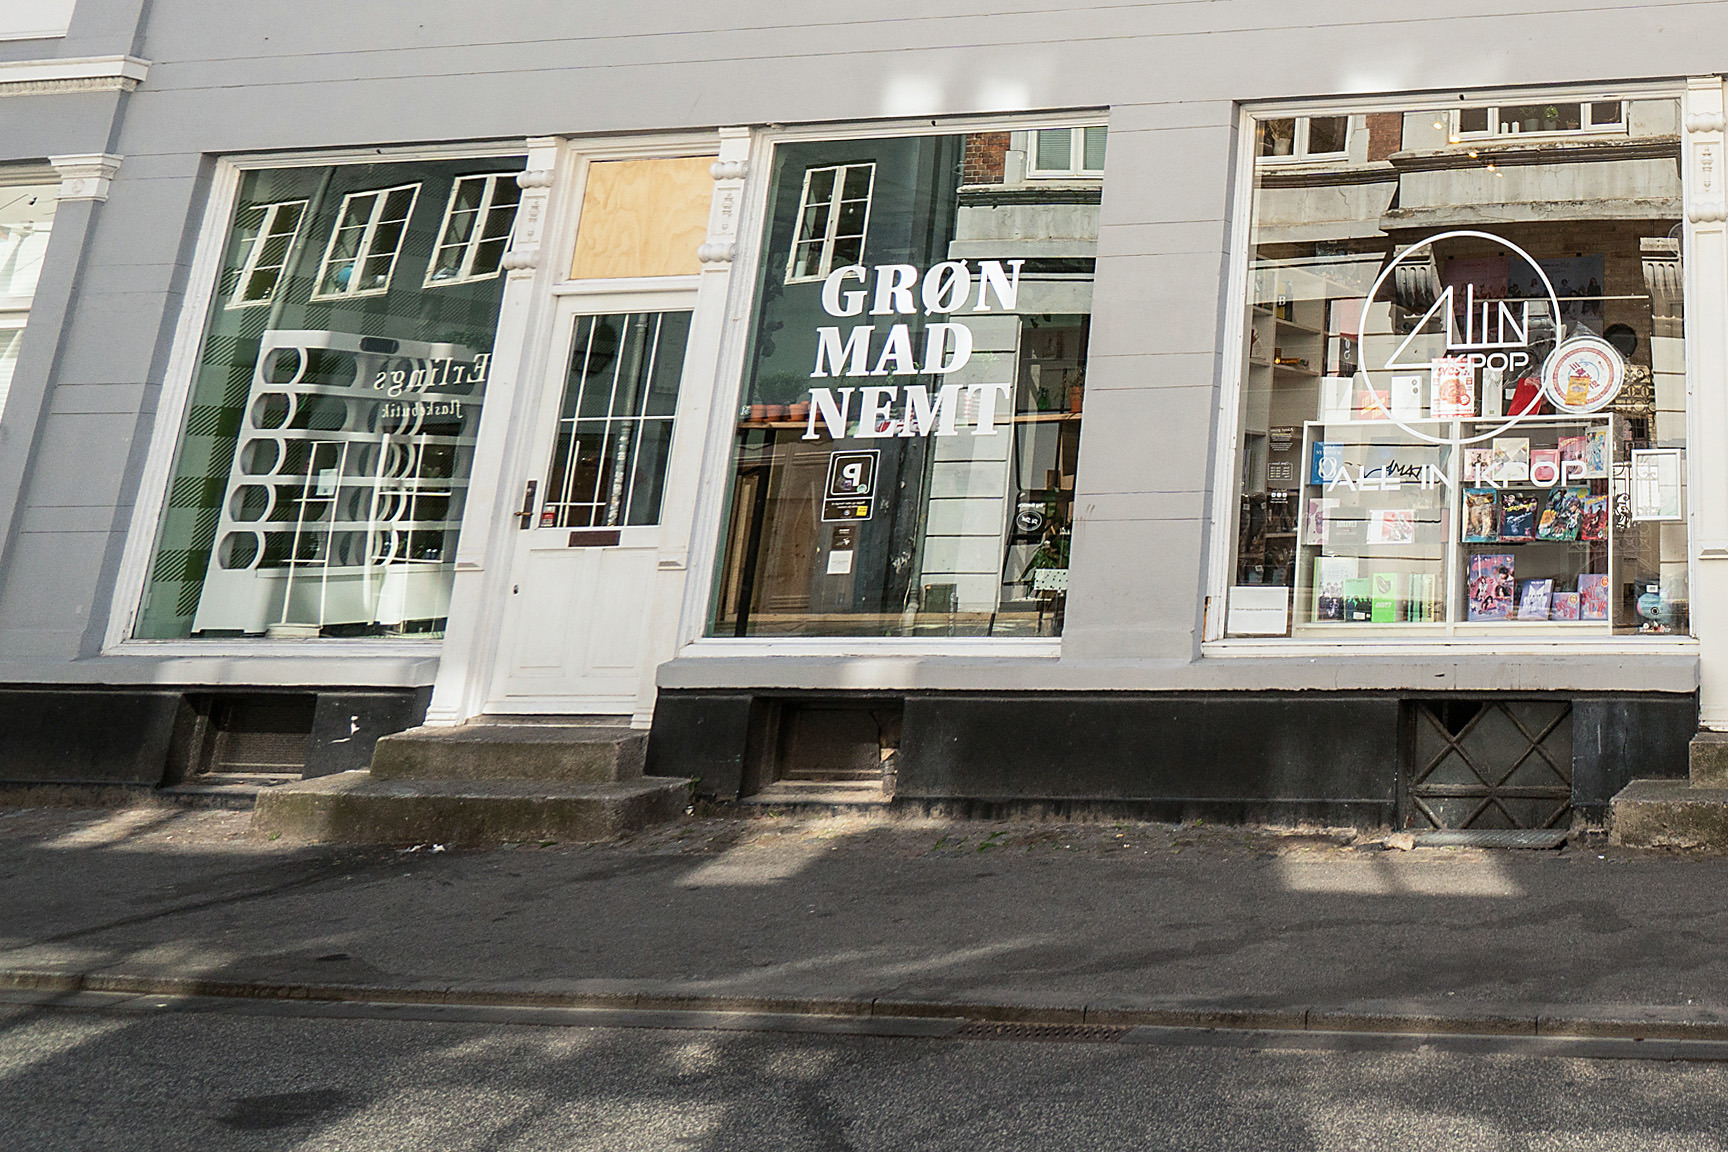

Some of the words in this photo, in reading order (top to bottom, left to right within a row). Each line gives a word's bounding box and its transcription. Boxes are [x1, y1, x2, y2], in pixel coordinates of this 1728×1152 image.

[821, 259, 1025, 317] GRØN
[810, 323, 973, 378] MAD
[1447, 352, 1529, 372] KPOP
[801, 382, 1011, 440] NEMT
[1327, 465, 1401, 492] ALL
[1421, 463, 1453, 491] IN
[1475, 460, 1587, 488] KPOP
